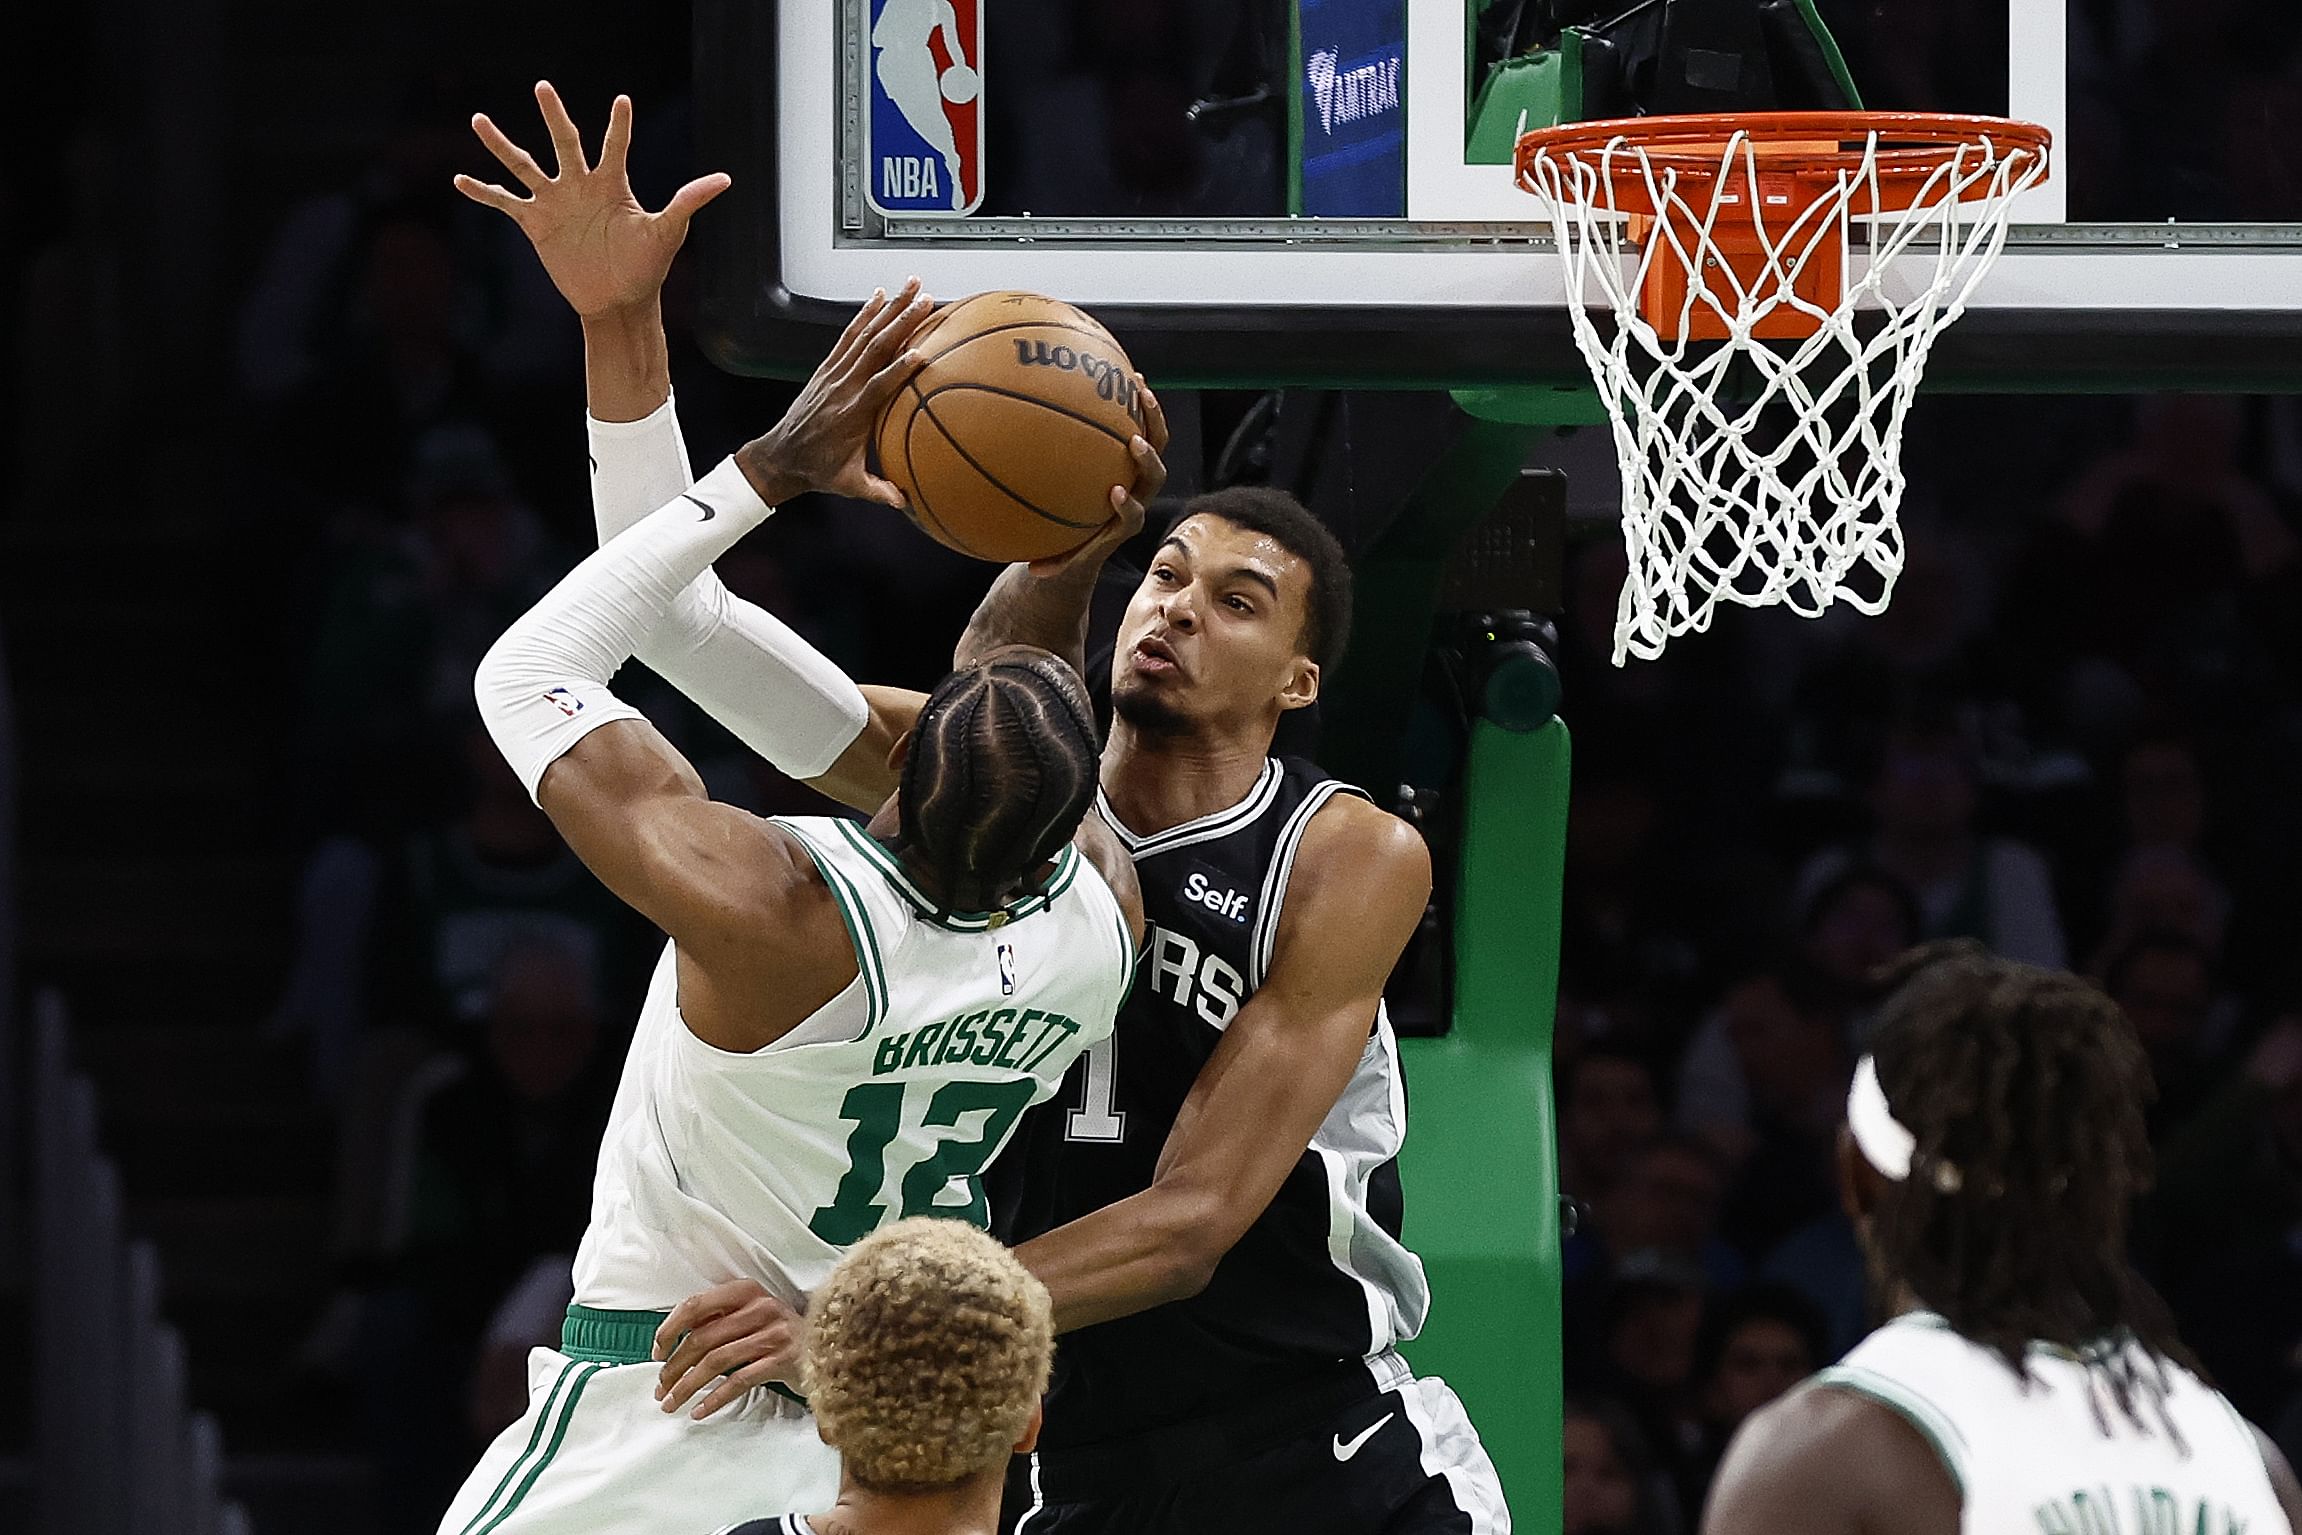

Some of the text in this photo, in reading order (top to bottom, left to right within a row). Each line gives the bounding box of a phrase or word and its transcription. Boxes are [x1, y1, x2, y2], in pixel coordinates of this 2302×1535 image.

[883, 156, 939, 198] NBA
[1184, 872, 1250, 923] Self.
[873, 1008, 1081, 1077] BRISSETT
[808, 1077, 1038, 1247] 12
